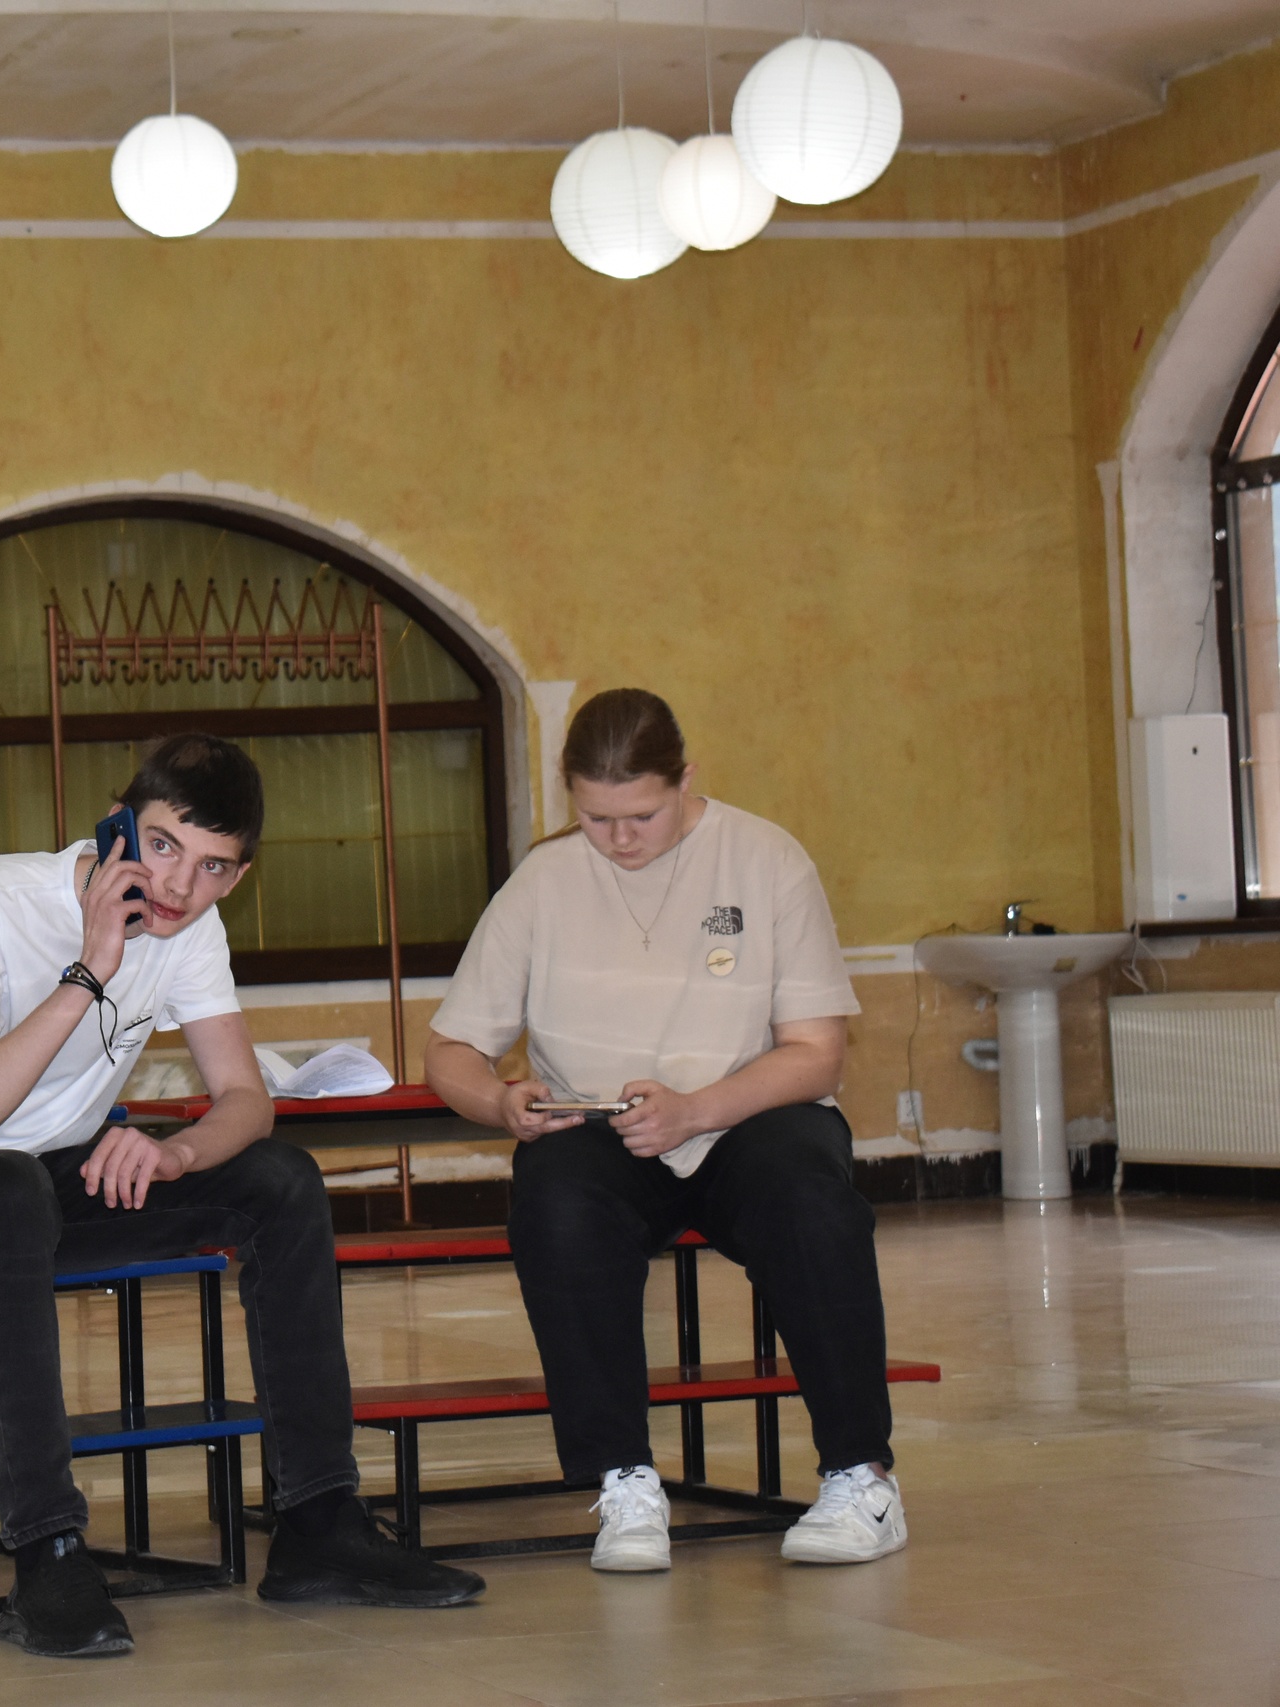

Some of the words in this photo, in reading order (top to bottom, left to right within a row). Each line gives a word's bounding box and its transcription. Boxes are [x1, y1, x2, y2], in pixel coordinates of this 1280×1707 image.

[712, 905, 730, 916] THE
[701, 915, 732, 930] NORTH
[708, 925, 733, 936] FACE
